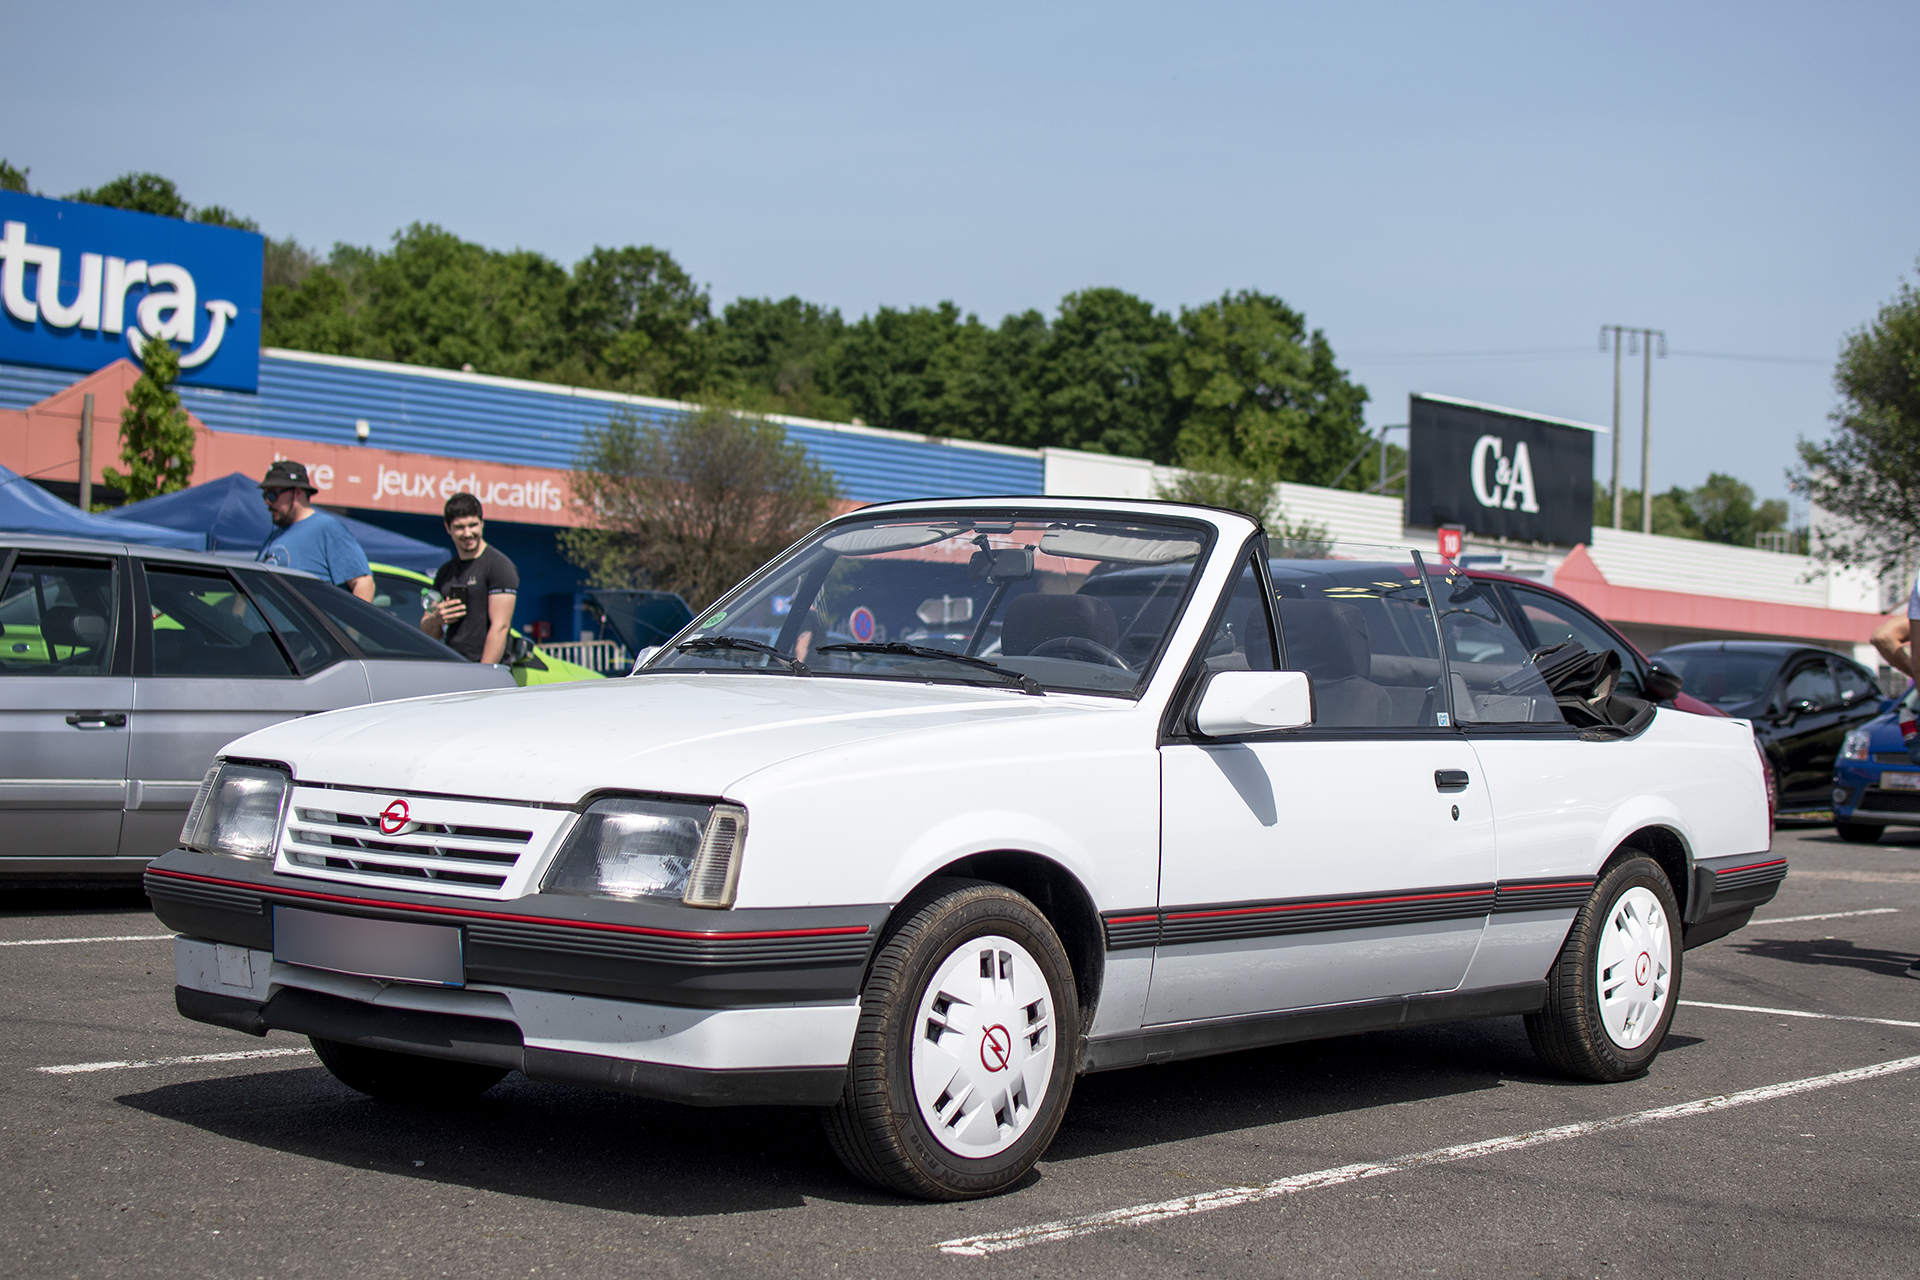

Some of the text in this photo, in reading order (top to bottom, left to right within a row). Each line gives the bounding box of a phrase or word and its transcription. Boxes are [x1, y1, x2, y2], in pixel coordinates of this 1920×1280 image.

[0, 220, 196, 343] tura
[372, 464, 436, 501] jeux
[439, 470, 563, 511] éducatifs
[1470, 434, 1539, 514] C&A
[1444, 534, 1458, 553] 10
